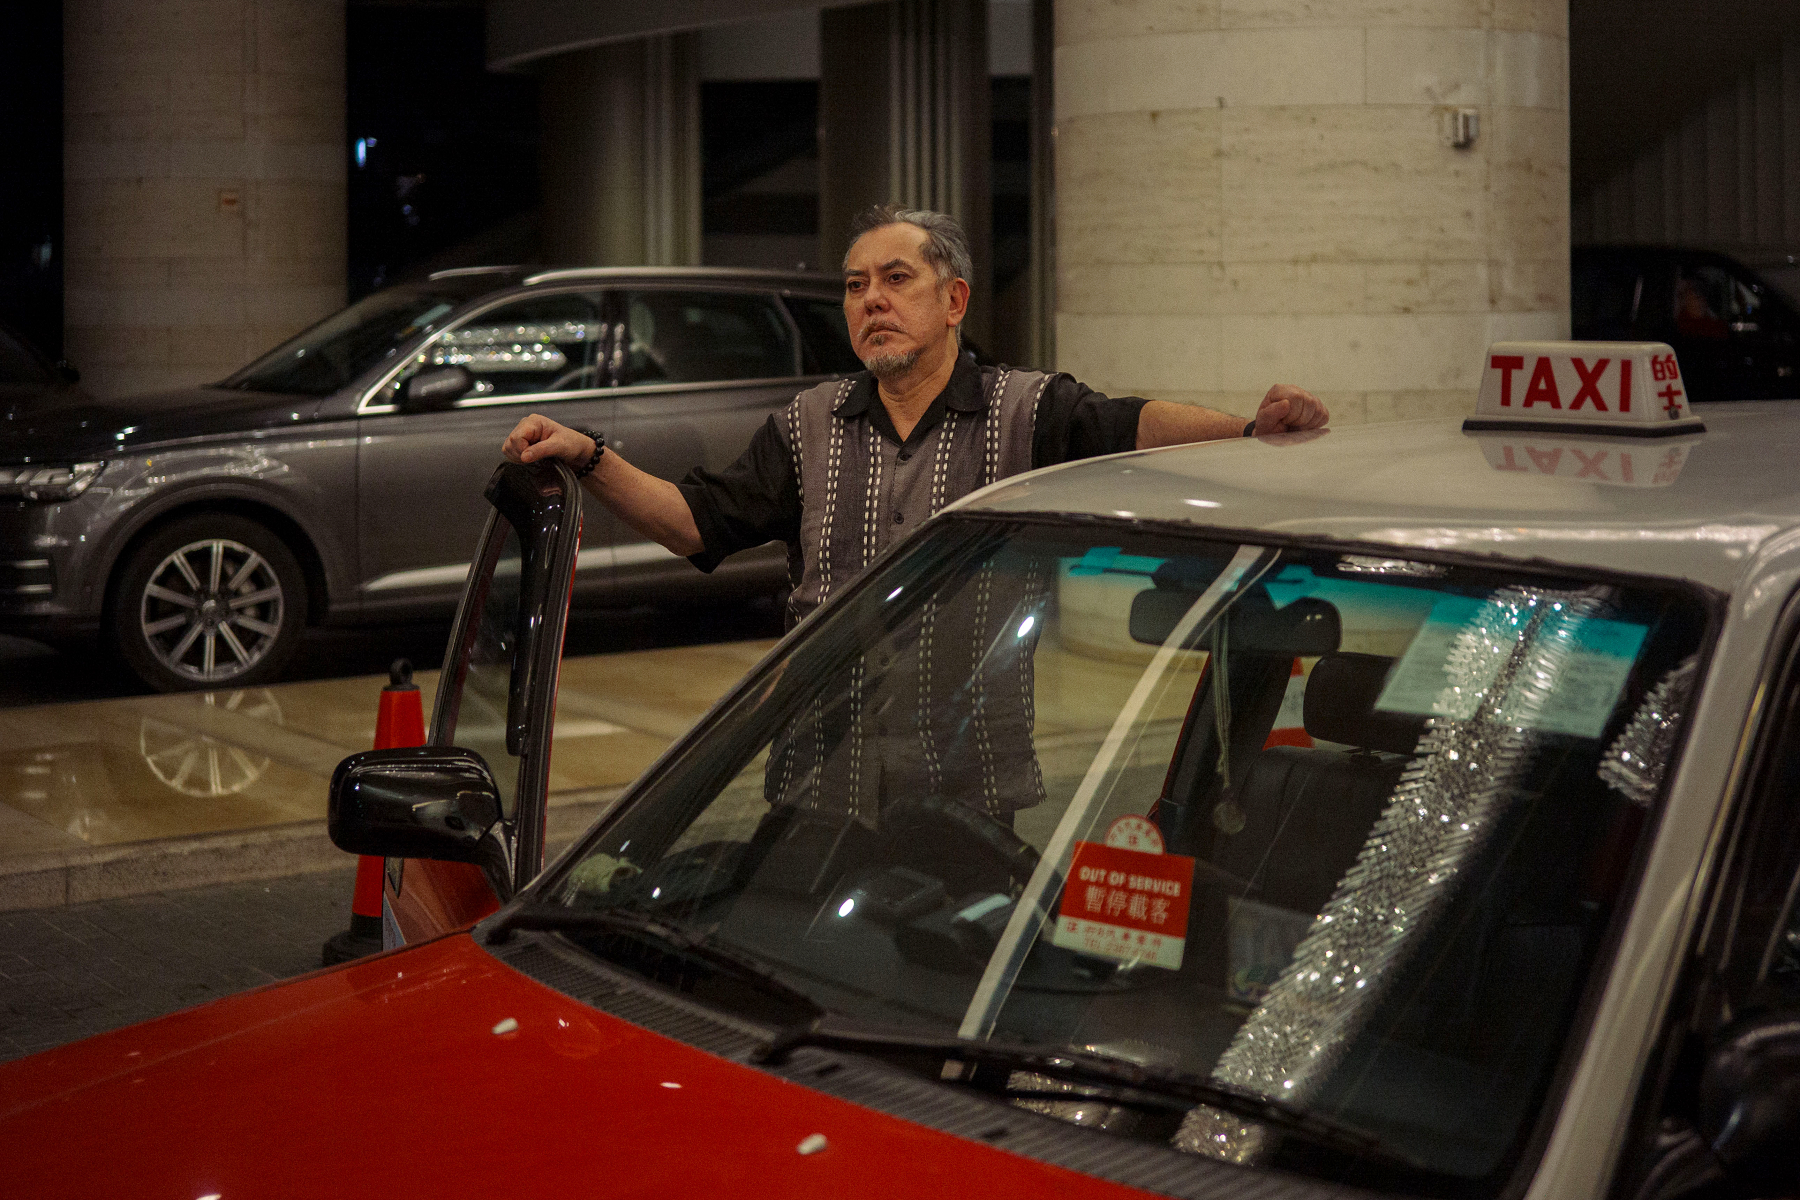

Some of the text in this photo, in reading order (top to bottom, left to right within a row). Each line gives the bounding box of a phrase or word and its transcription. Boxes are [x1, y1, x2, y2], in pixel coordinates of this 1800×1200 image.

[1490, 354, 1633, 413] TAXI
[1651, 353, 1683, 412] 的士
[1080, 865, 1181, 896] OUT OF SERVICE
[1085, 885, 1170, 924] 暫停載客
